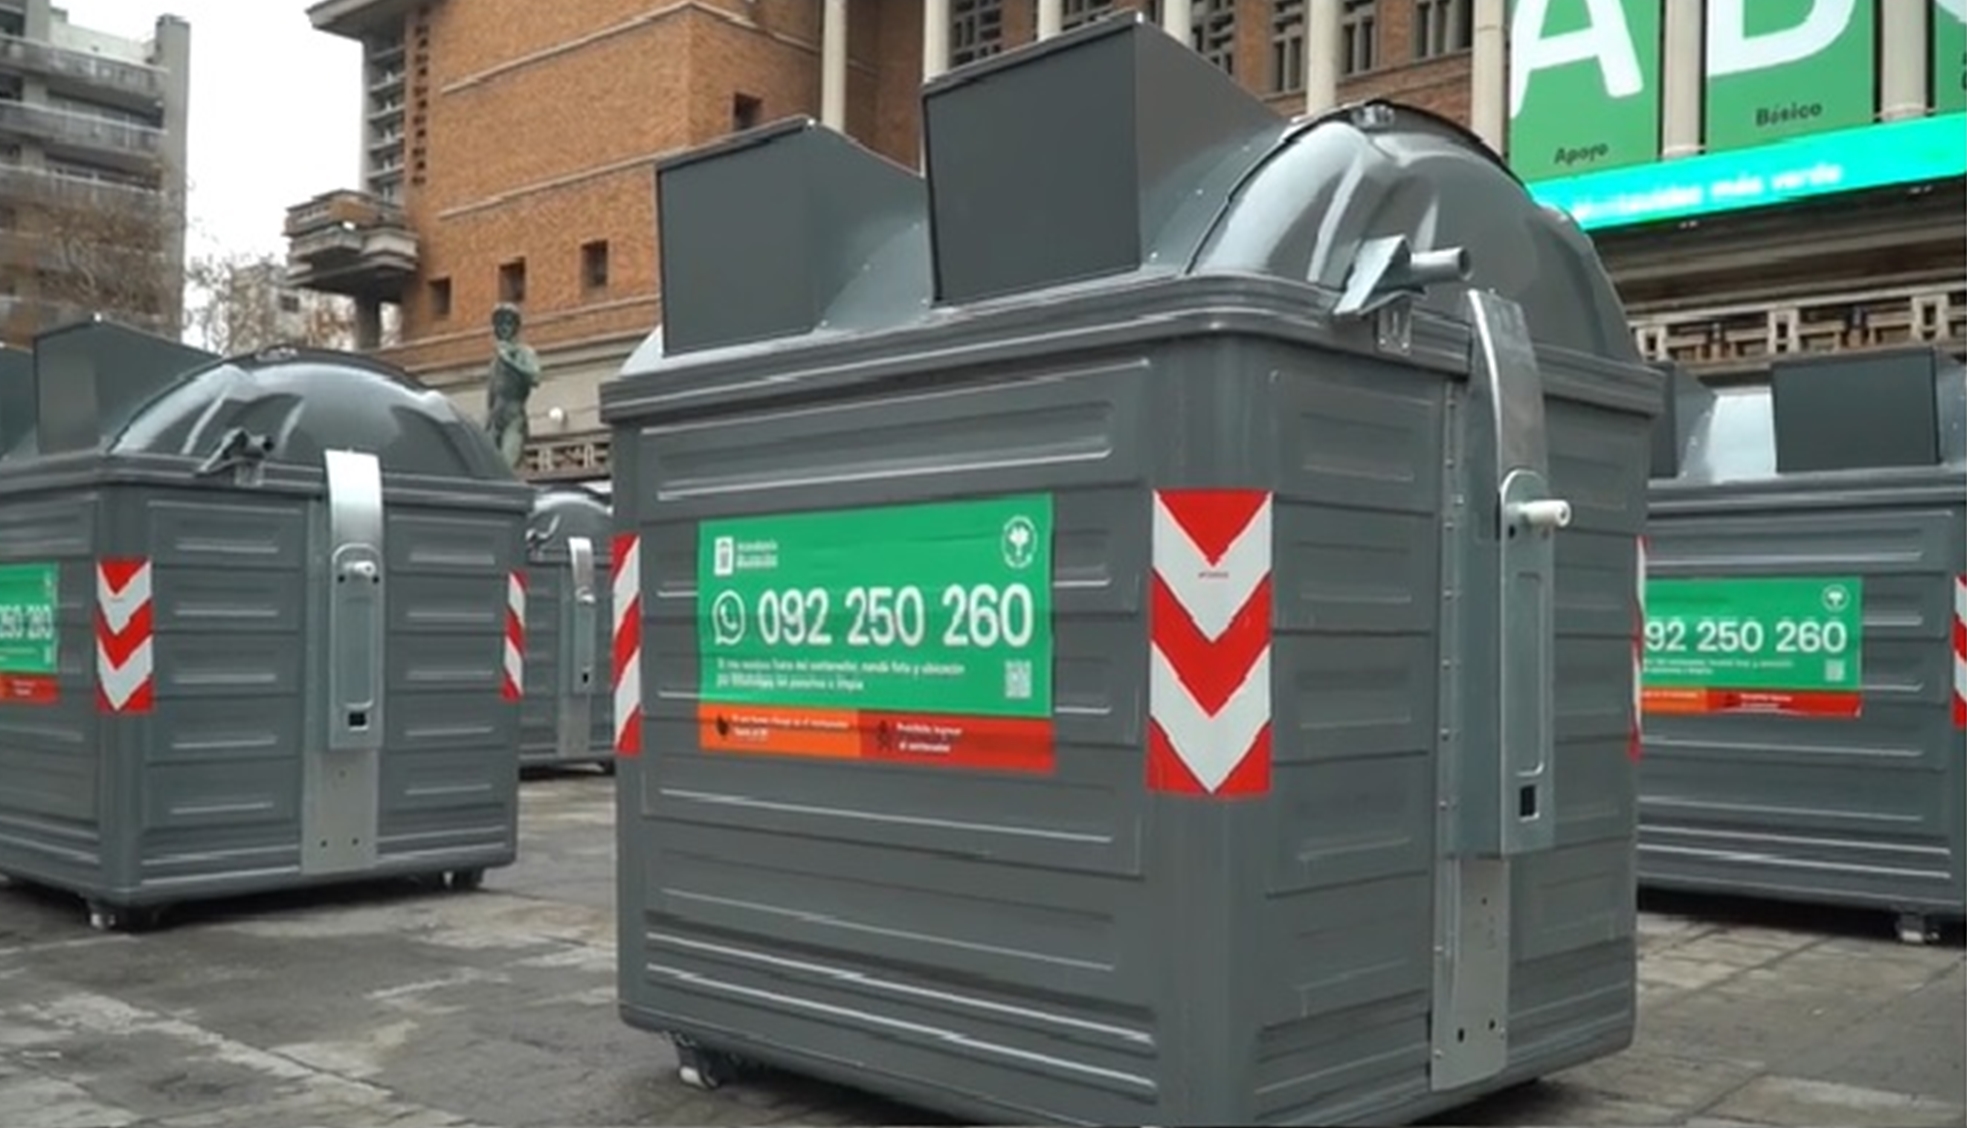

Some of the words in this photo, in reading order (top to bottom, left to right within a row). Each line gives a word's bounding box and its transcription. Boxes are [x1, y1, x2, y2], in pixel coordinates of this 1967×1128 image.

[1554, 141, 1609, 165] Apoyo
[1772, 163, 1842, 191] verde
[758, 588, 832, 645] 092
[845, 586, 925, 647] 250
[942, 583, 1034, 648] 260
[1645, 620, 1687, 652] 92
[1696, 620, 1764, 652] 250
[1776, 620, 1848, 653] 260
